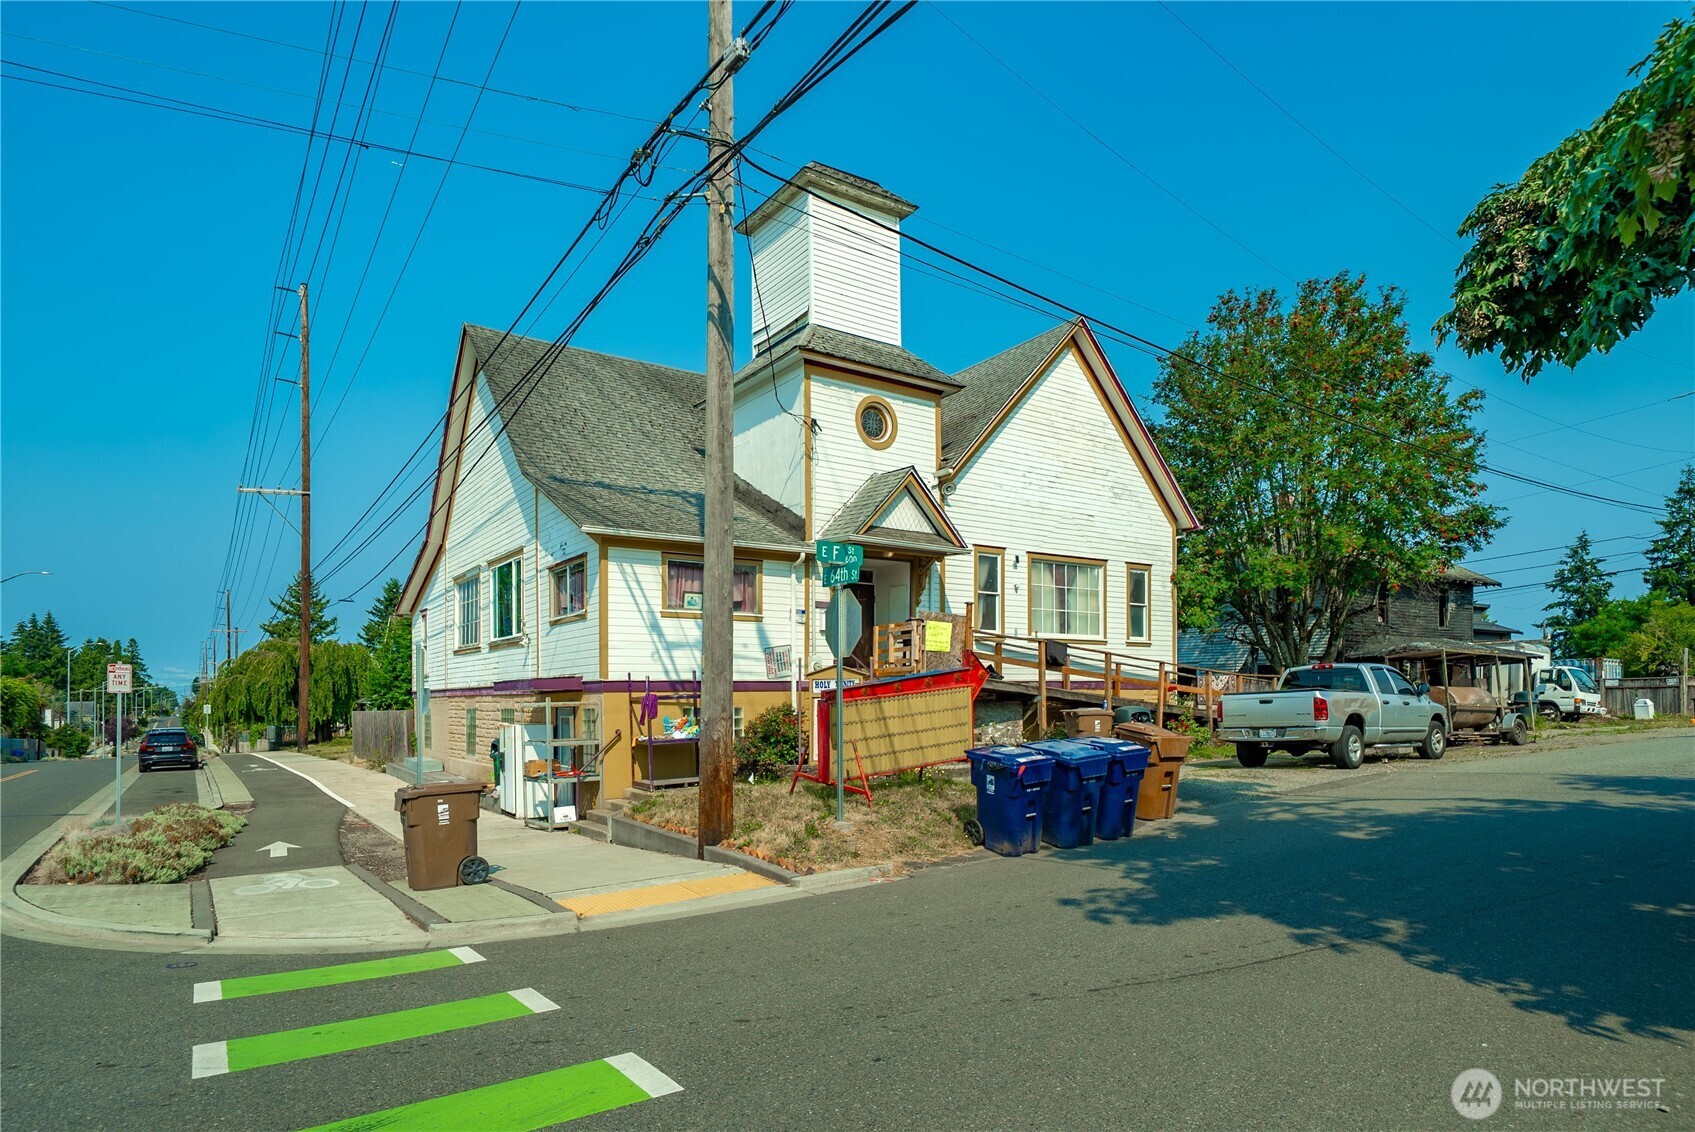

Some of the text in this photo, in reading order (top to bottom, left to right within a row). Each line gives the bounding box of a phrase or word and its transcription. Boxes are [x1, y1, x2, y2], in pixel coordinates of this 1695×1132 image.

[822, 546, 855, 560] E F St
[824, 566, 858, 584] E 64th St
[815, 681, 831, 689] HOLY
